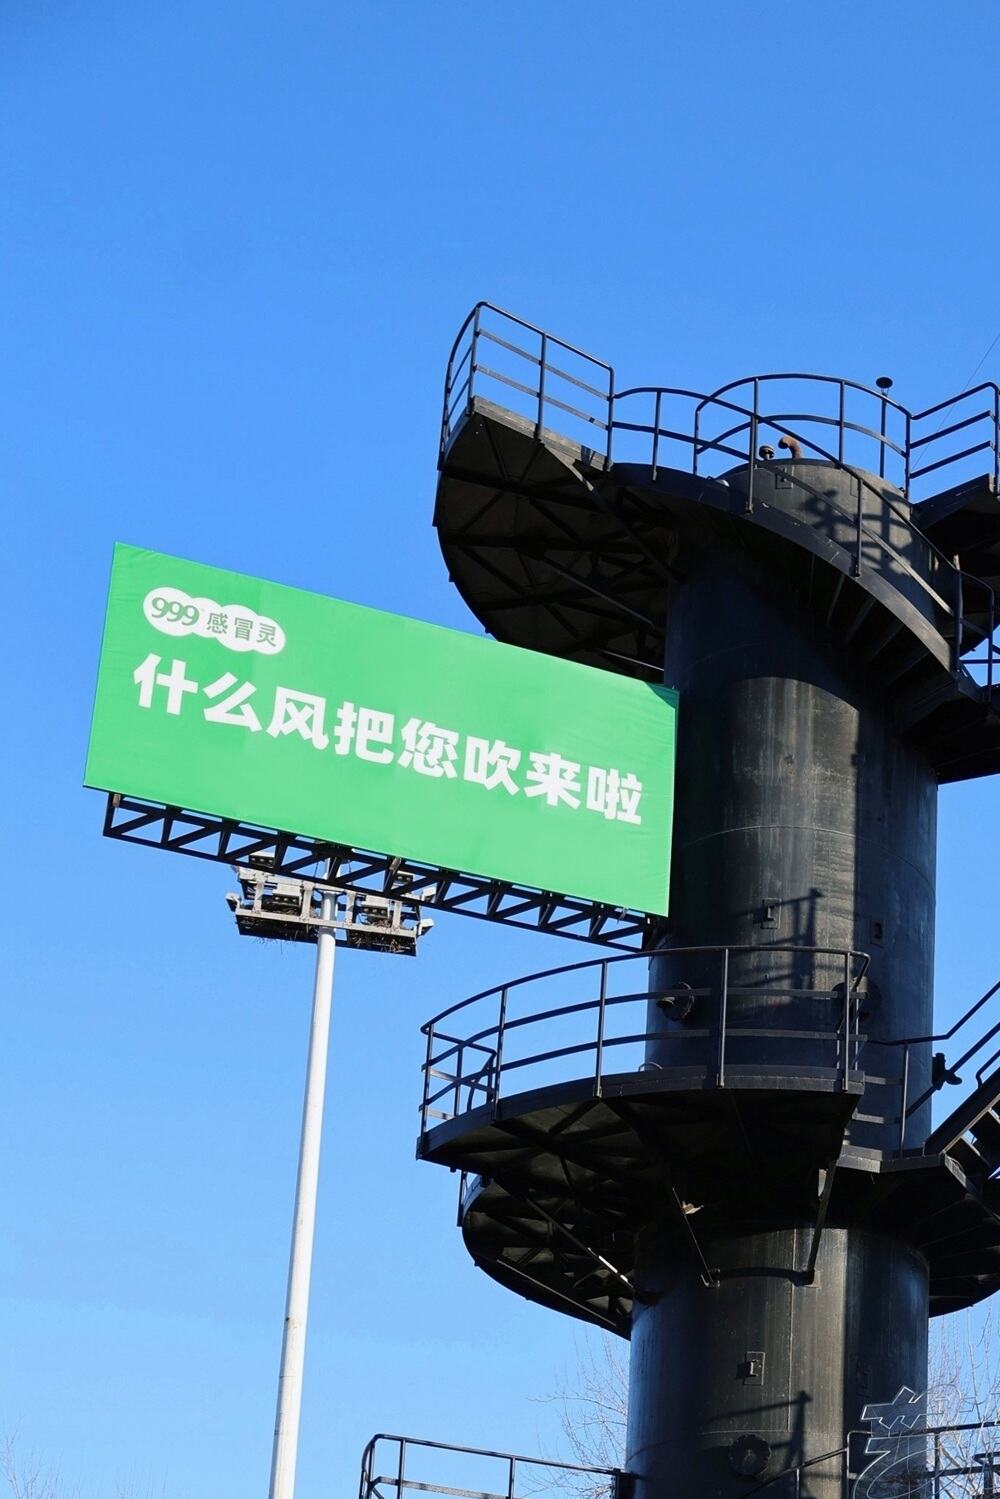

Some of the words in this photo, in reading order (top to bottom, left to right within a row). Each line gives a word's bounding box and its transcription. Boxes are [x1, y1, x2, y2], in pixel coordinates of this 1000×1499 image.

[151, 597, 200, 626] 999
[206, 612, 277, 647] 感冒灵
[133, 653, 643, 825] 什么风把您吹来啦
